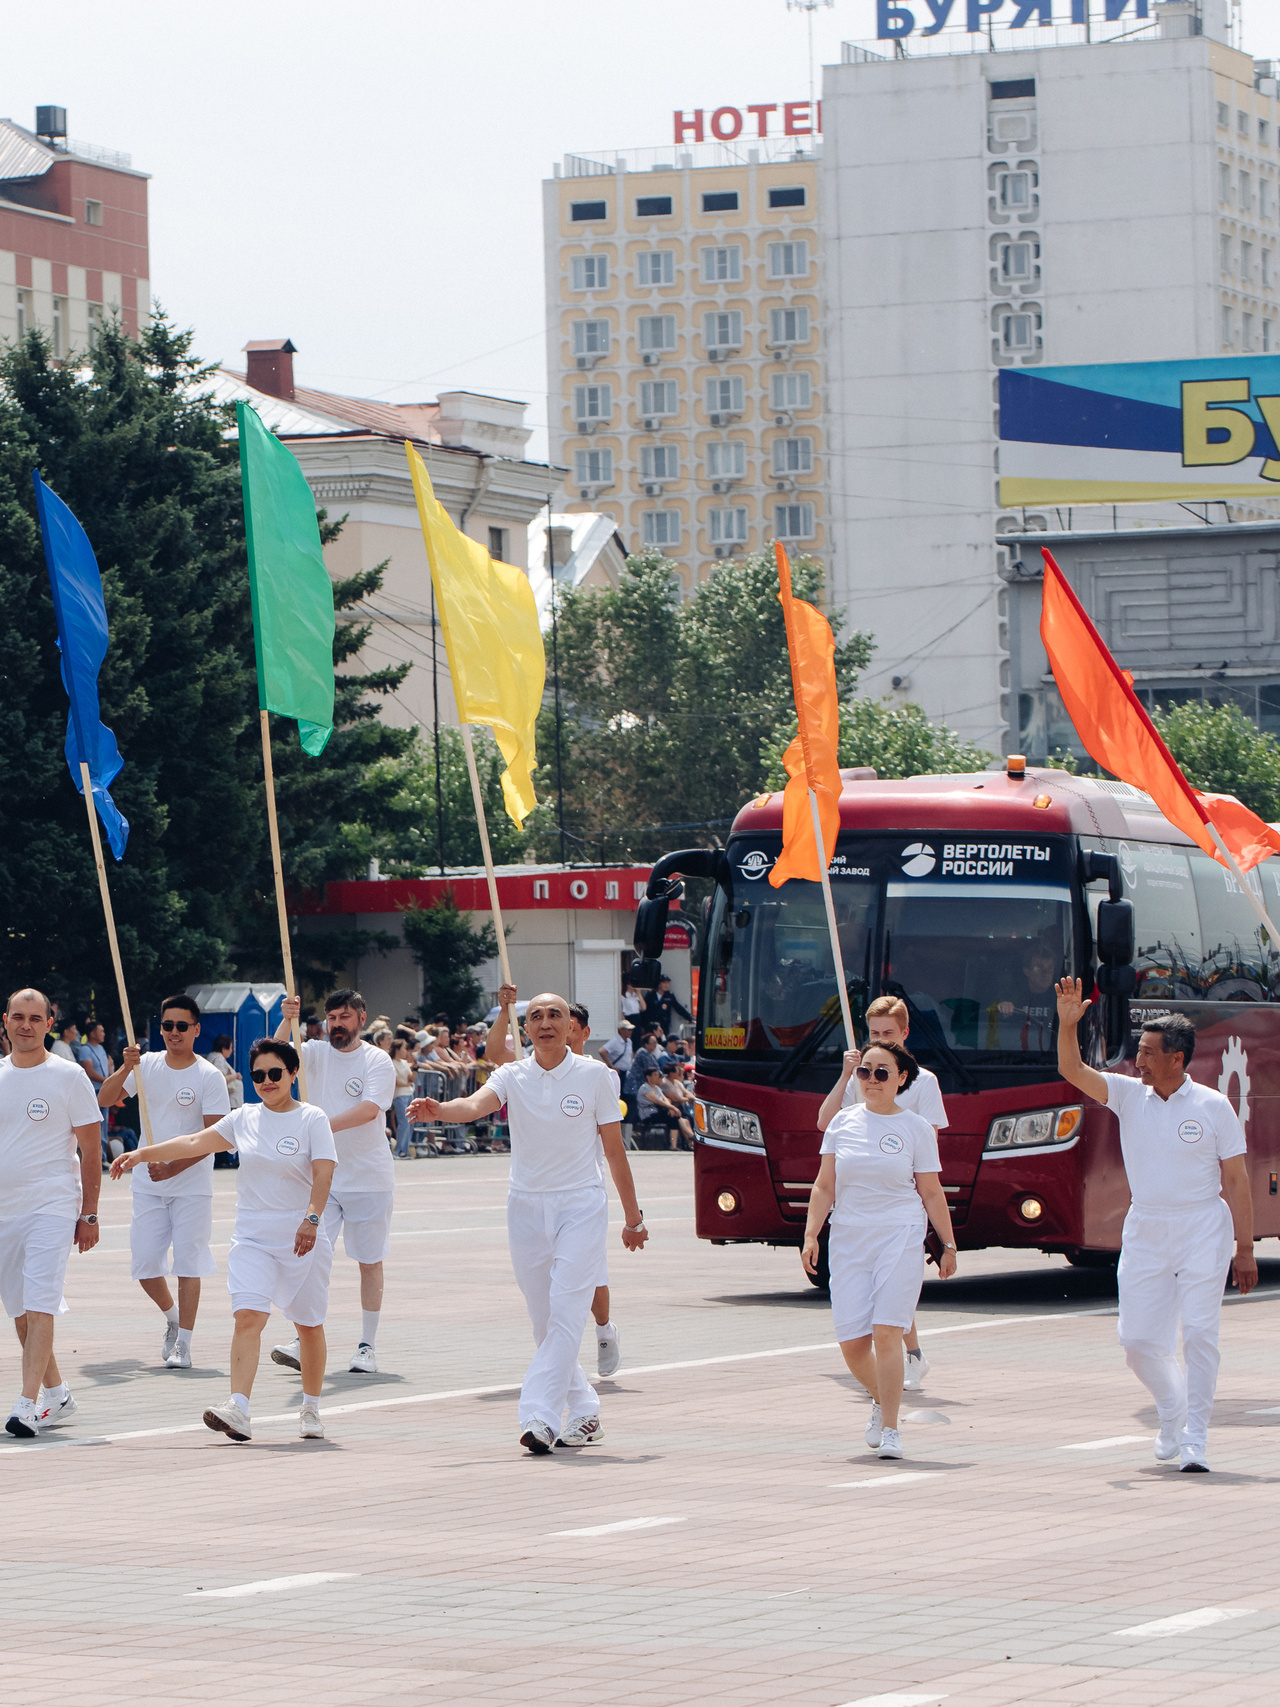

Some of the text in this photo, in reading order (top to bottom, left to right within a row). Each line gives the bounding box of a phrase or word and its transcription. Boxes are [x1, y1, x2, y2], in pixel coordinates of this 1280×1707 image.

[673, 100, 822, 144] HOTE
[943, 844, 1051, 861] ВЕРТОЛЕТЫ
[839, 867, 870, 876] ЗАВОД
[942, 861, 1014, 876] РОССИИ
[705, 1032, 745, 1047] ЗАКАЗНОЙ
